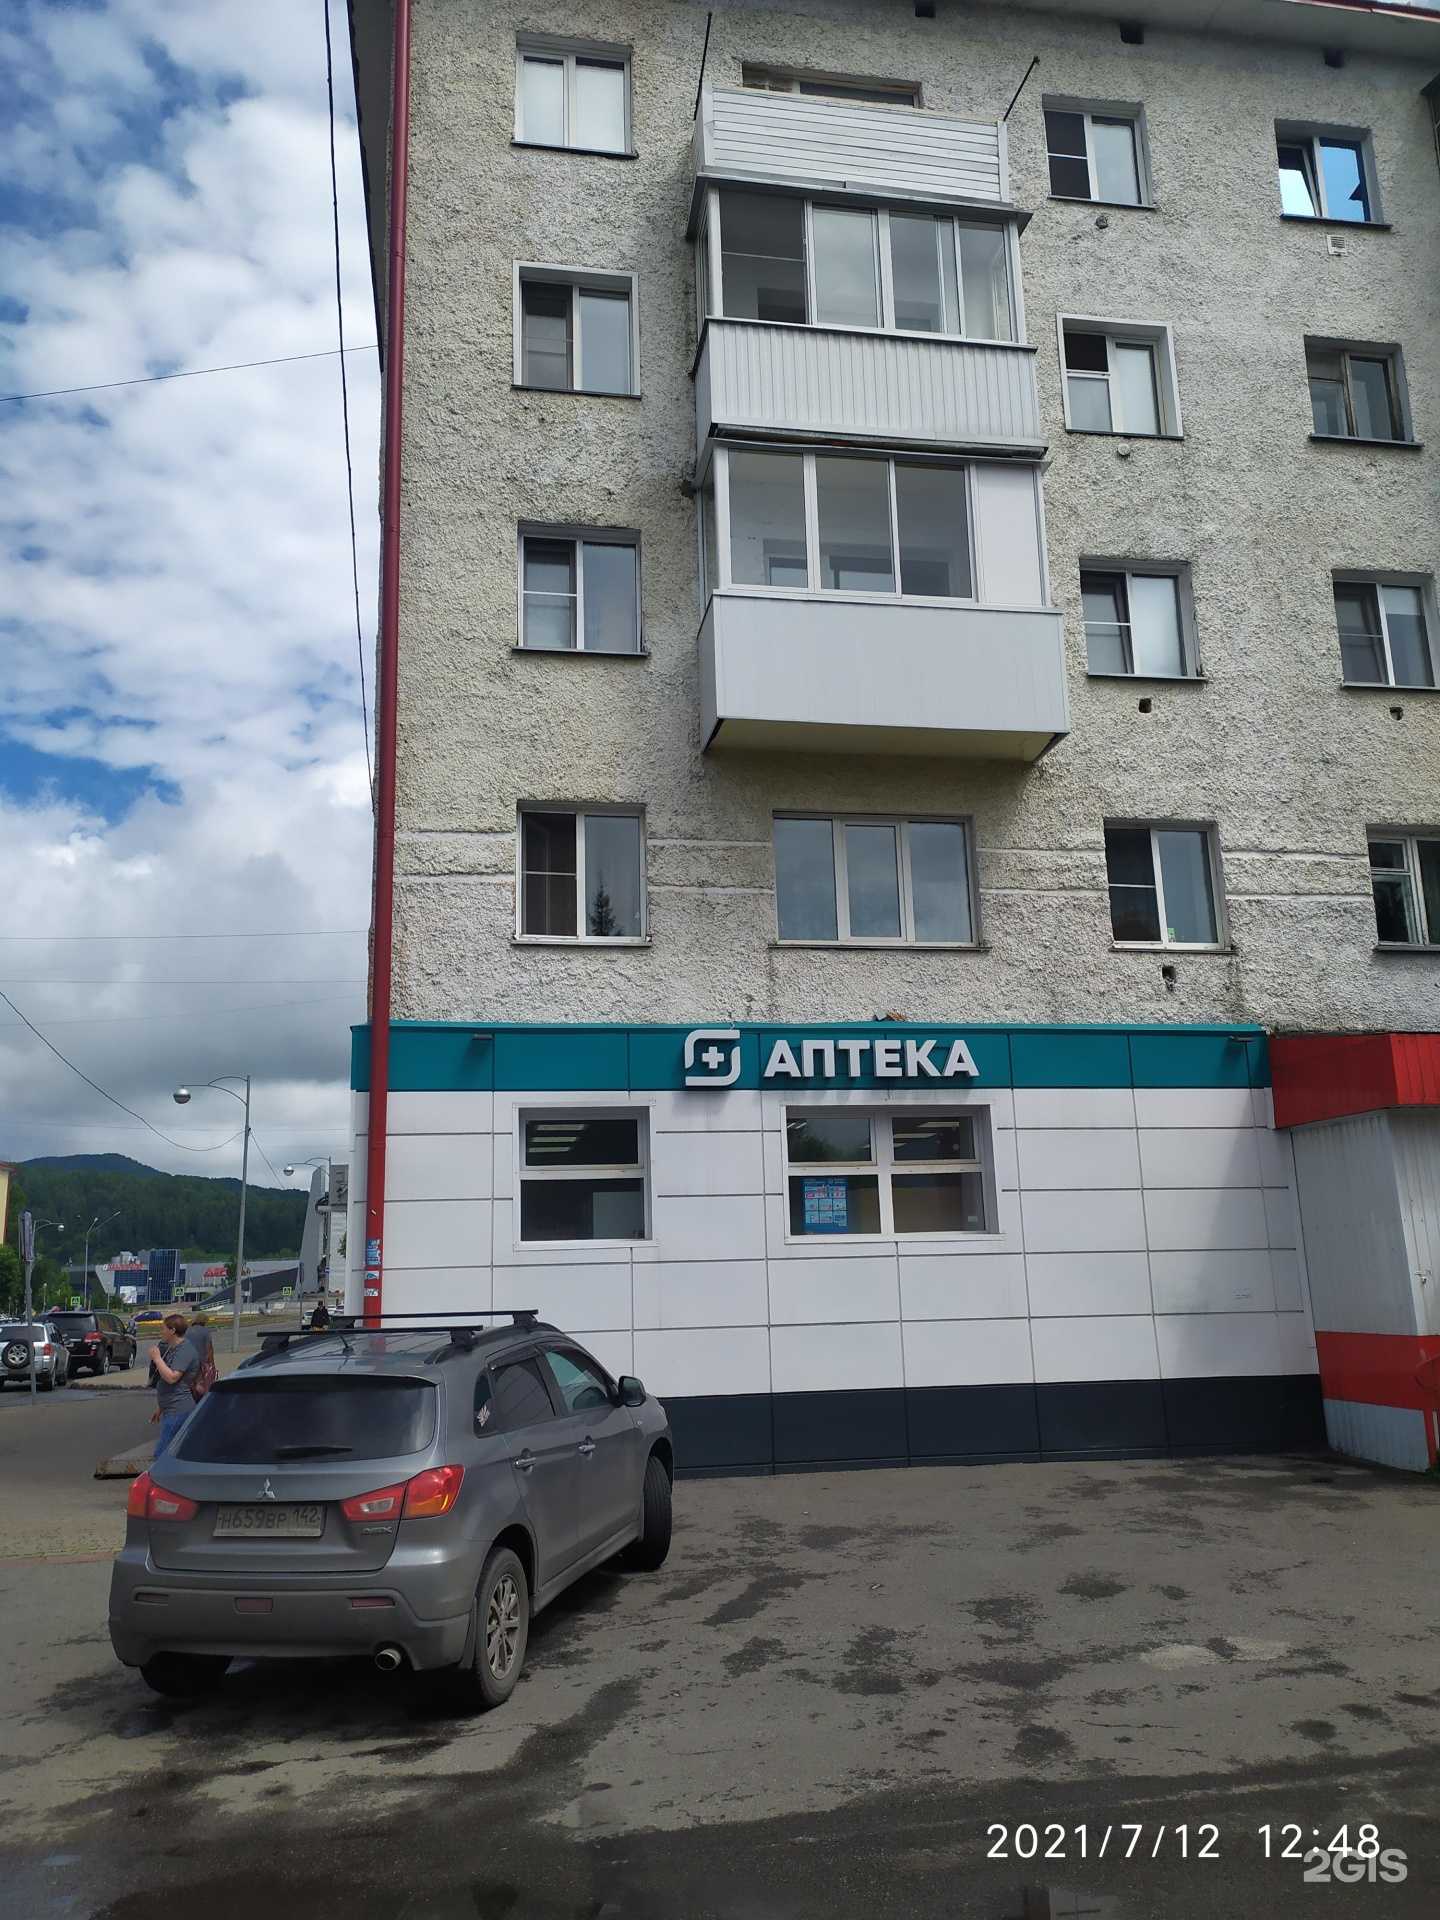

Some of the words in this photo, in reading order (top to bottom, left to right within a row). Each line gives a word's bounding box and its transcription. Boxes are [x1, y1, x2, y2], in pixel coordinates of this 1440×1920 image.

[763, 1039, 979, 1077] АПТЕКА
[221, 1508, 288, 1530] Н659ВР
[293, 1506, 318, 1526] 142
